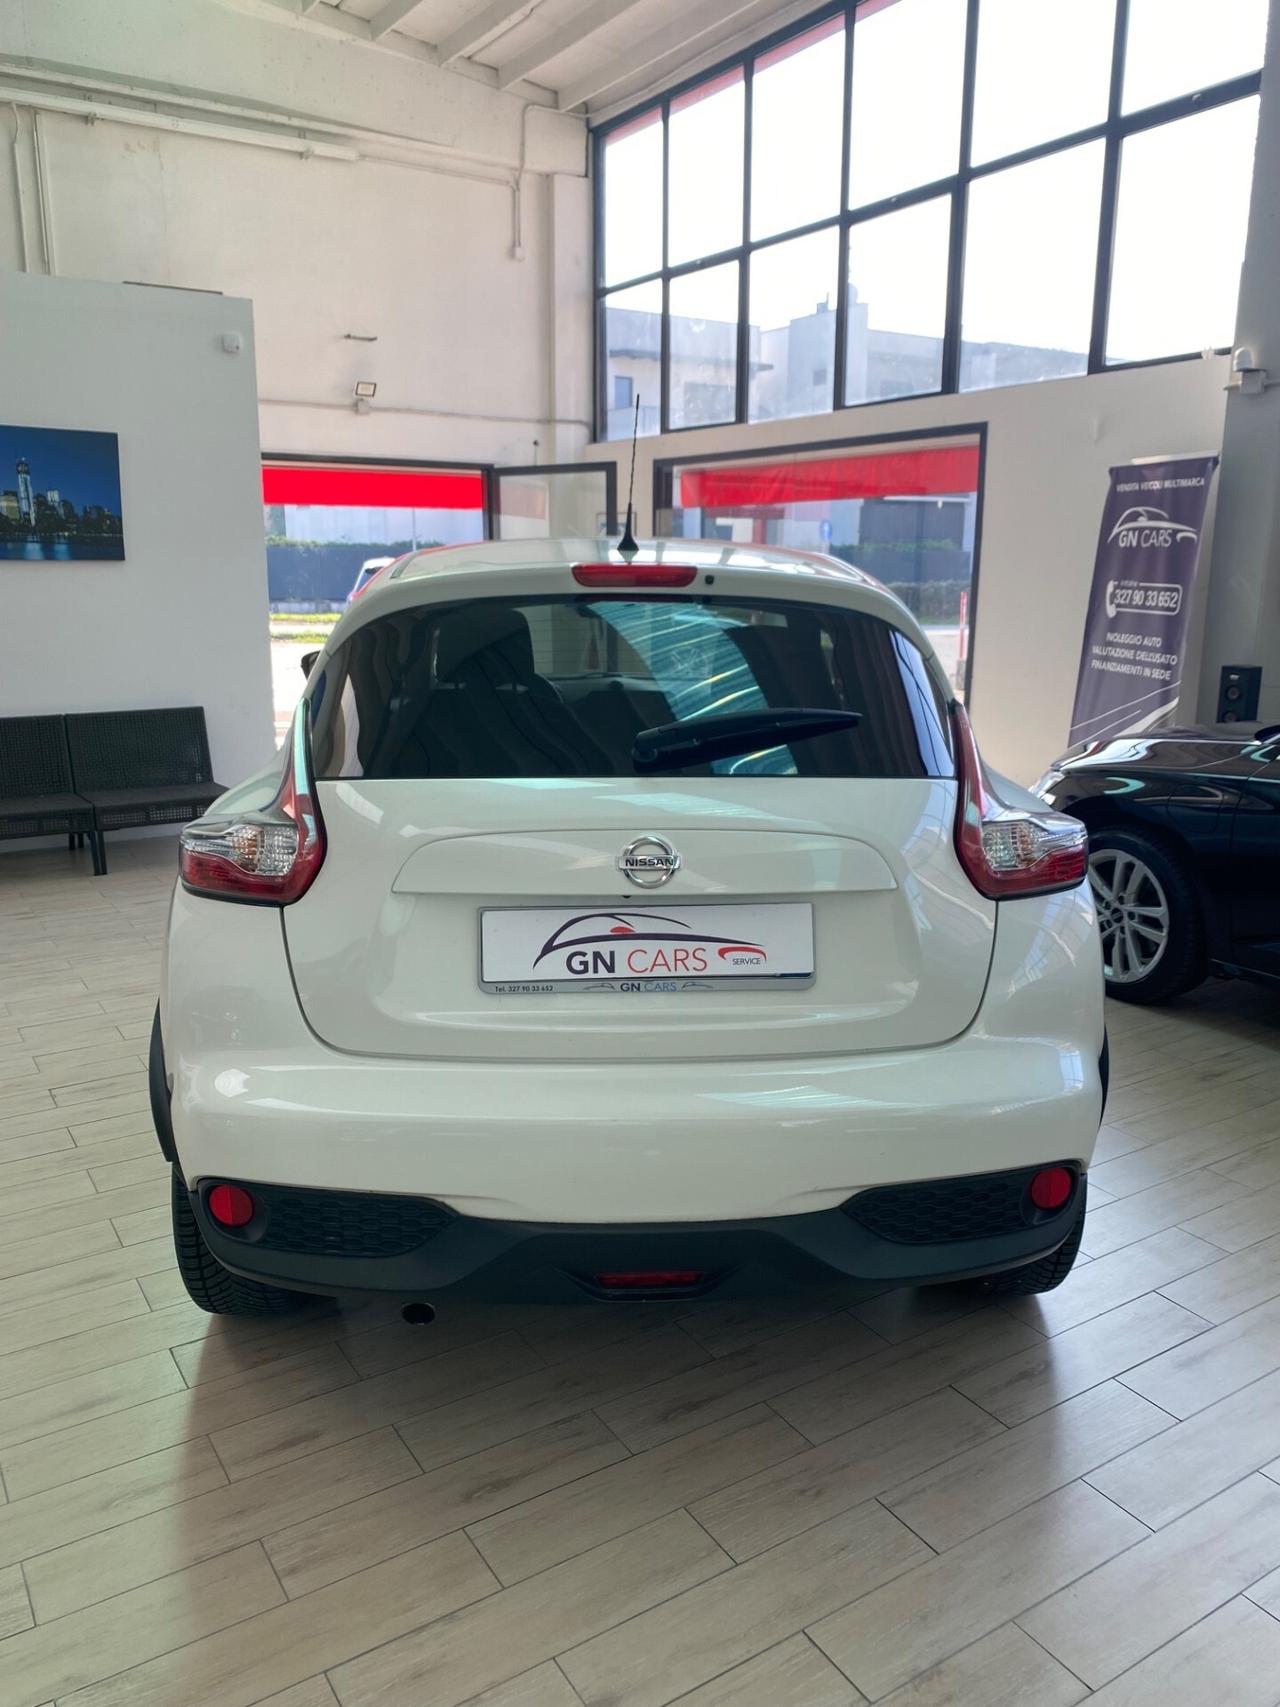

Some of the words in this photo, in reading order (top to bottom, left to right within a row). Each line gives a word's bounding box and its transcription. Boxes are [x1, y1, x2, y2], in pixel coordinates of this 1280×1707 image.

[1119, 530, 1138, 548] GN
[1141, 529, 1172, 548] CARS
[1114, 589, 1132, 605] 327
[1132, 590, 1145, 606] 90
[1145, 591, 1158, 607] 33
[1158, 591, 1179, 609] 652
[1106, 632, 1142, 646] NOLEGGIO
[1143, 636, 1162, 648] AUTO
[1092, 645, 1135, 660] VALUTAZIONE
[1091, 659, 1142, 676] FINANZIAMENTI
[1143, 666, 1151, 677] IN
[1151, 668, 1172, 680] SEDE
[625, 858, 674, 867] NISSAN
[565, 950, 616, 975] GN
[626, 948, 708, 973] CARS
[732, 957, 761, 966] SERVICE
[508, 985, 520, 993] 327
[620, 982, 641, 992] GN
[644, 982, 677, 992] CARS
